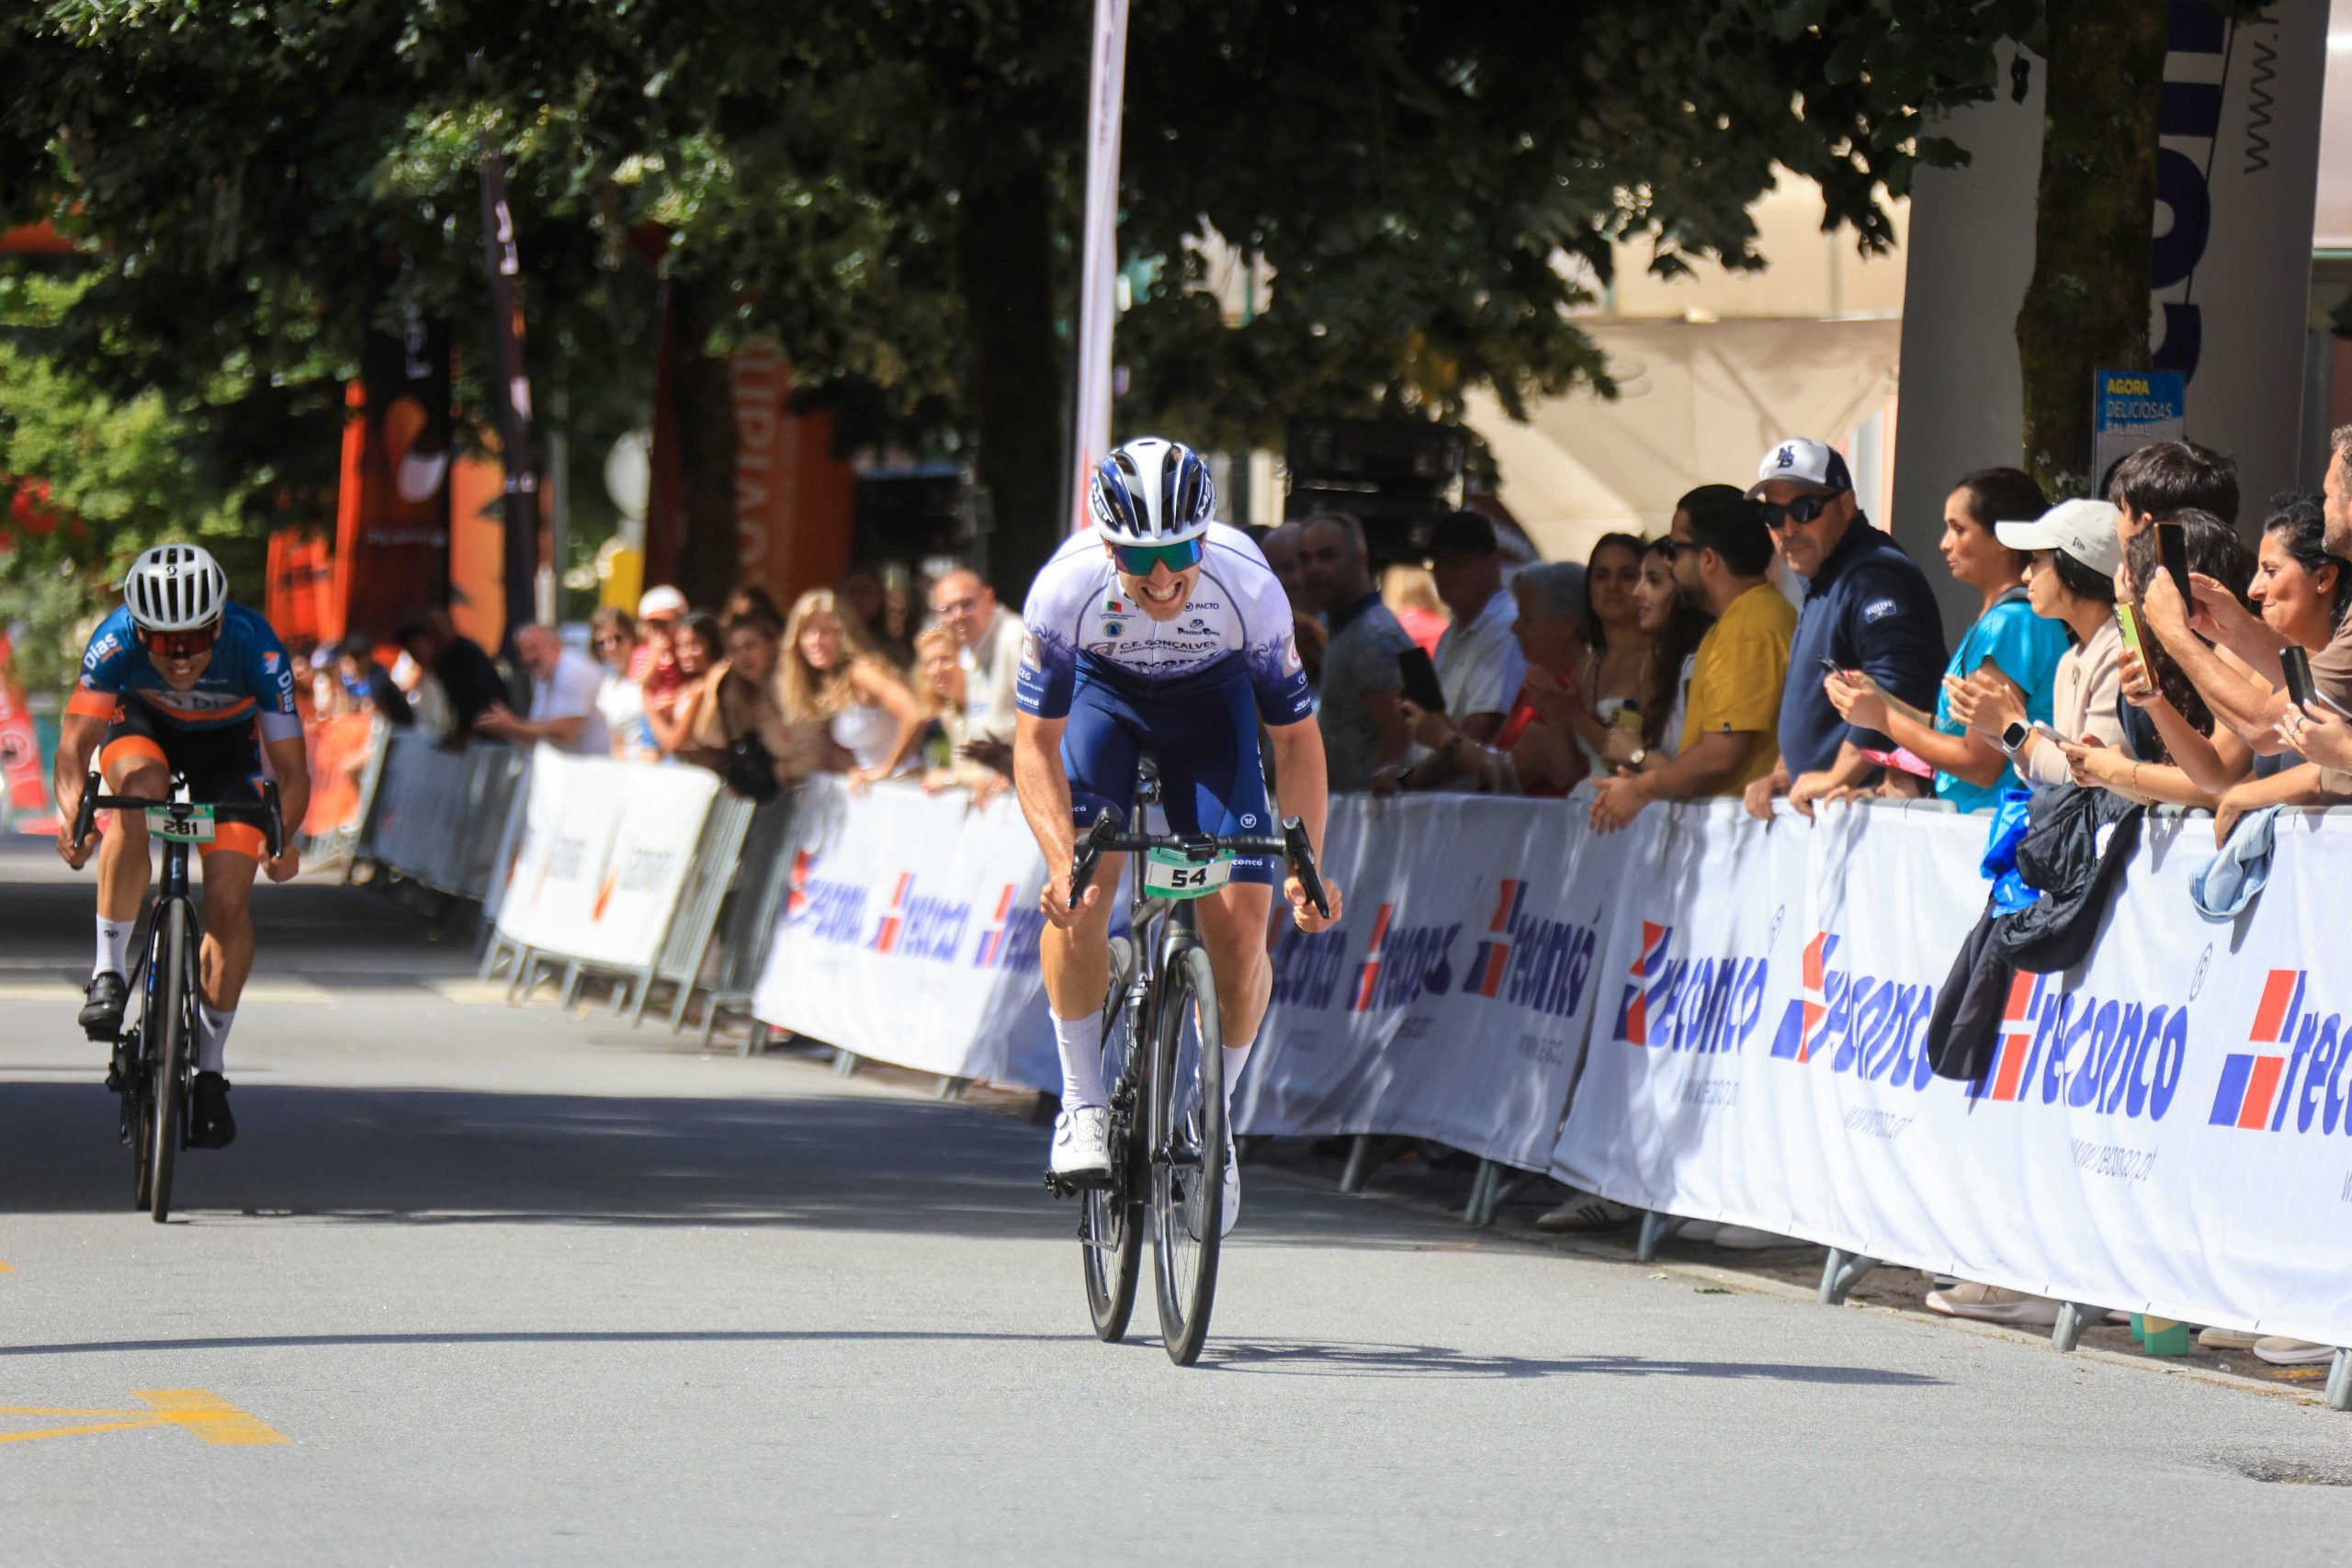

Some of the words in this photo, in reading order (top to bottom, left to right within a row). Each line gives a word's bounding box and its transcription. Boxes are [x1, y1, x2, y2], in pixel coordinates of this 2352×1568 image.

[2107, 378, 2150, 396] AGORA
[2107, 400, 2174, 420] DELICIOSAS
[2107, 423, 2153, 436] SALADAS
[83, 632, 119, 671] Dias
[1120, 641, 1142, 650] C.E.
[1145, 639, 1218, 650] GONÇALVES
[1018, 667, 1032, 682] CEG
[277, 670, 295, 713] Dias
[164, 819, 198, 836] 281
[1232, 857, 1264, 868] conco
[1171, 868, 1207, 888] 54
[2018, 992, 2188, 1122] reconco
[2270, 1010, 2352, 1137] rec
